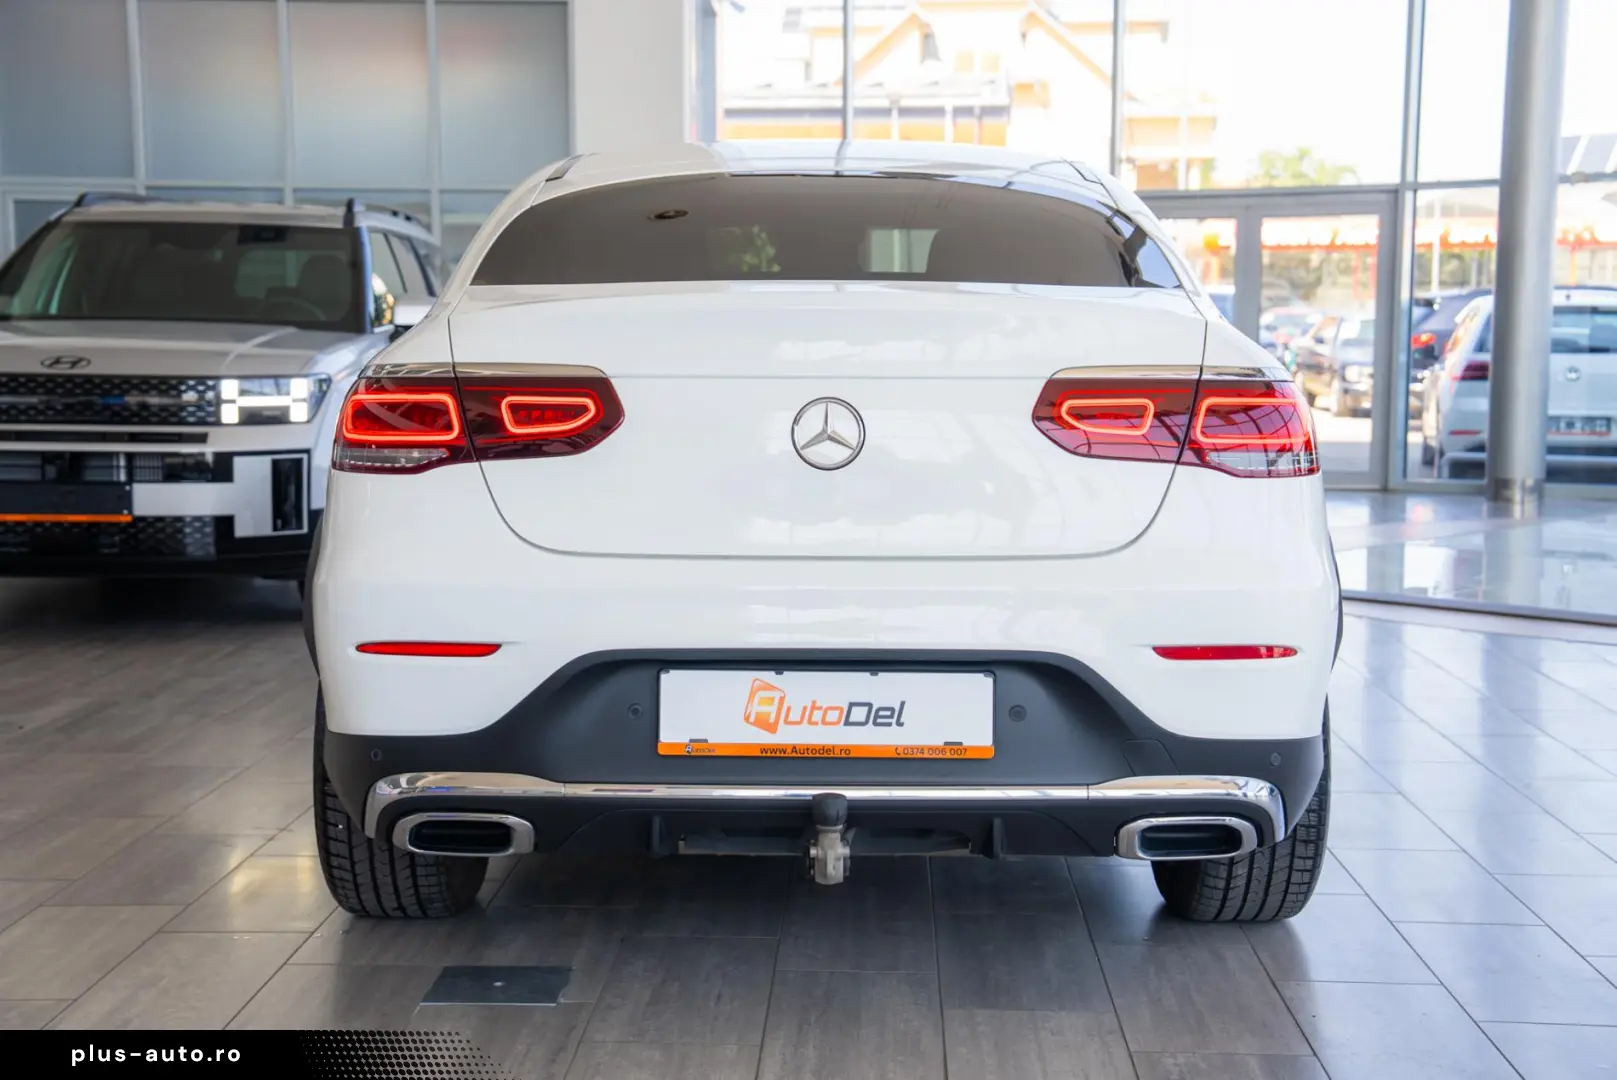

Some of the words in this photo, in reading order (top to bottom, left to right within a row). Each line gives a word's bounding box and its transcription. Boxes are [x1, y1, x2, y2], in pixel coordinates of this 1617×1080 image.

[744, 680, 906, 732] AutoDel
[760, 745, 851, 756] www.Autodel.ro
[902, 747, 925, 756] 0374
[928, 747, 947, 756] 006
[949, 747, 968, 756] 007
